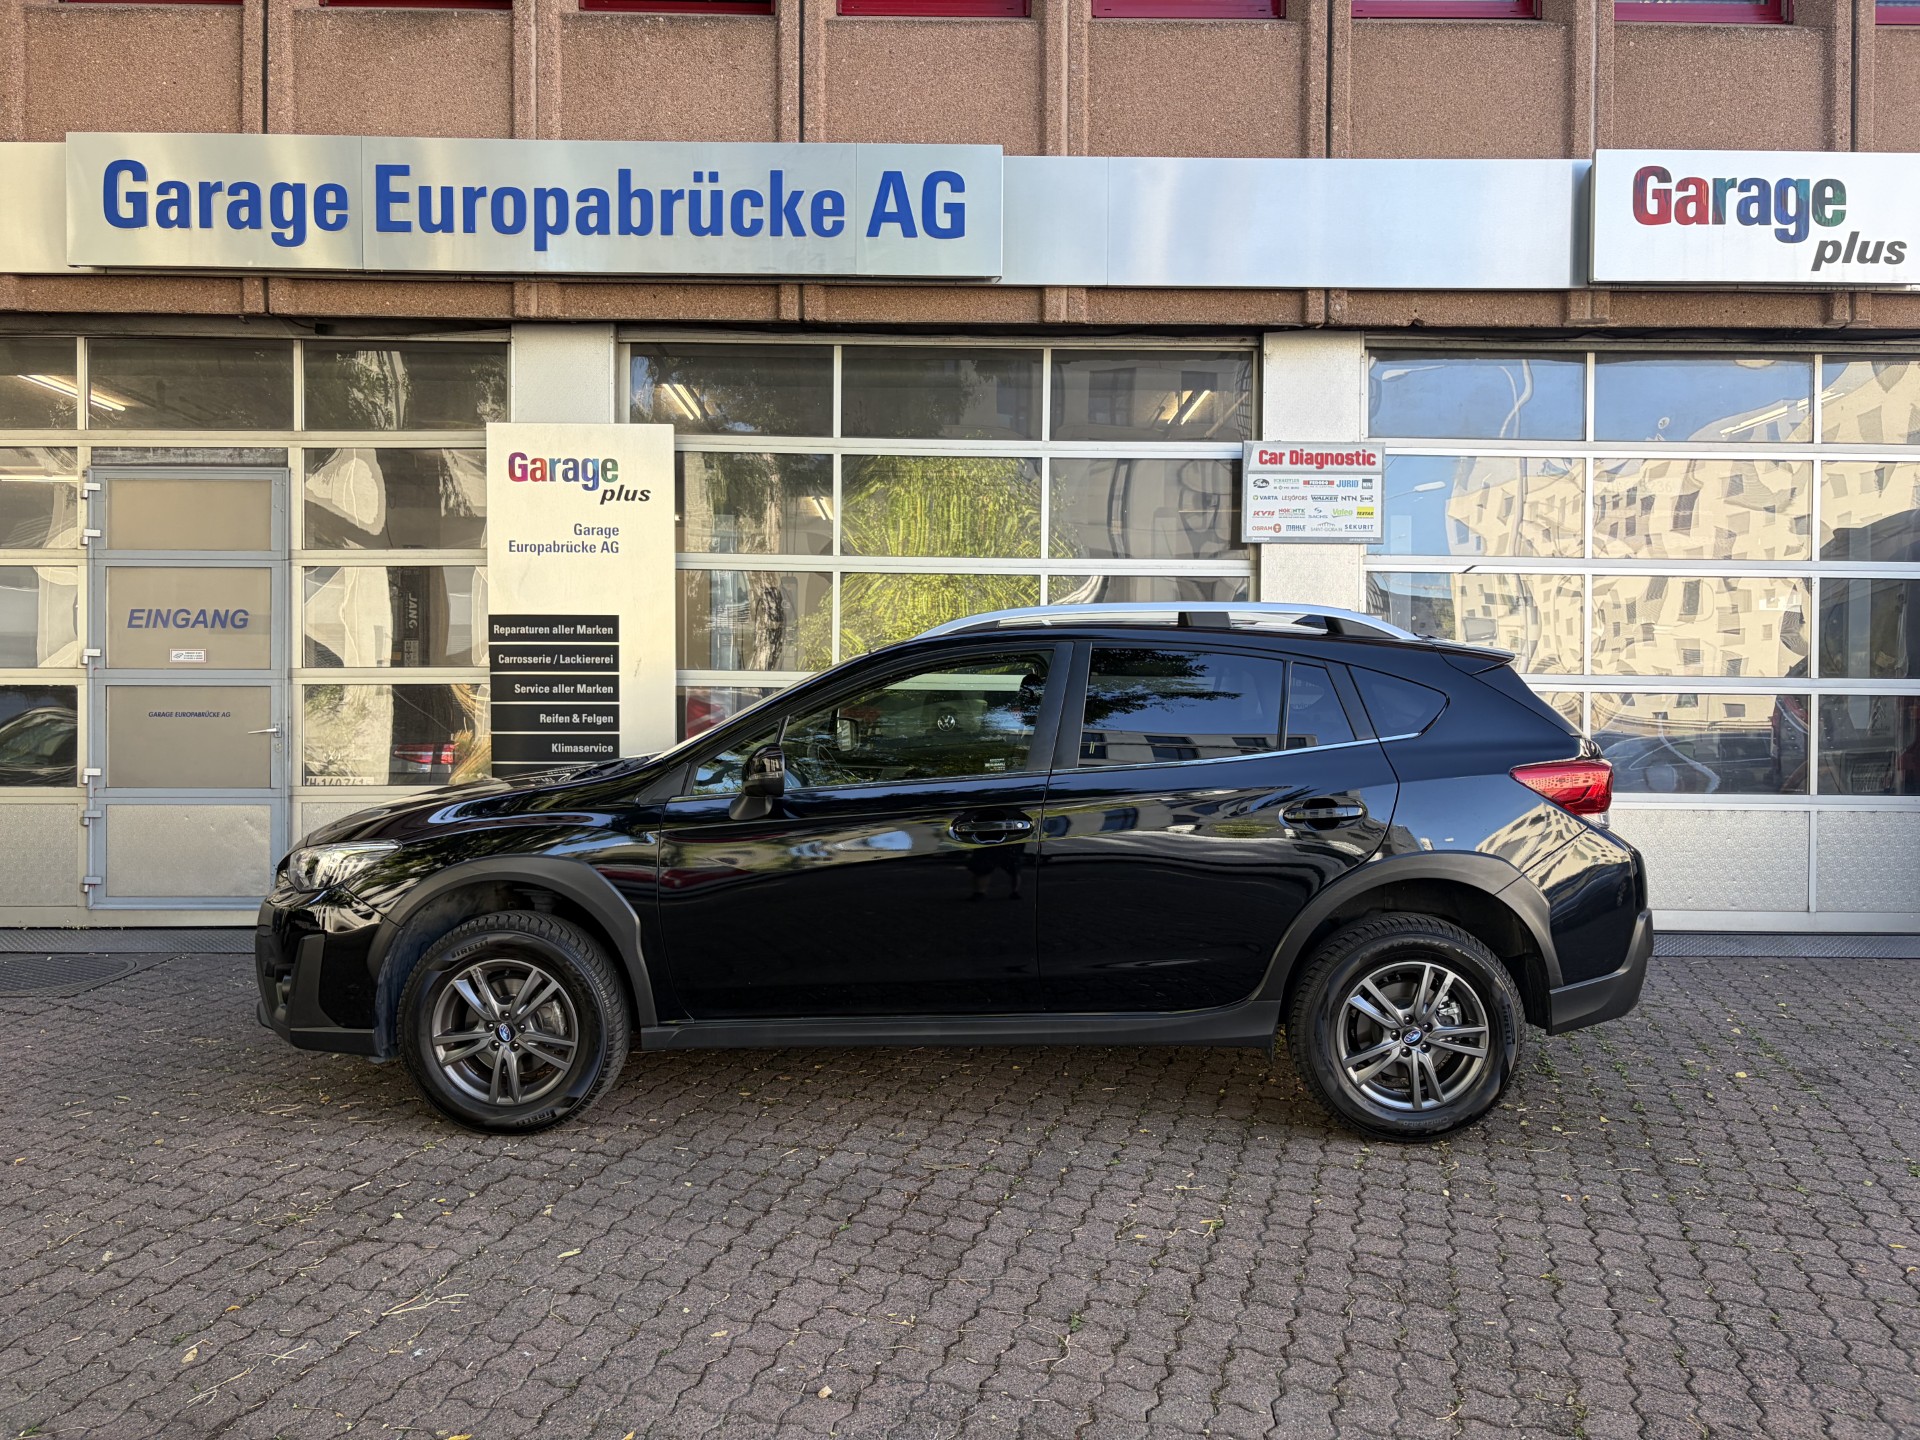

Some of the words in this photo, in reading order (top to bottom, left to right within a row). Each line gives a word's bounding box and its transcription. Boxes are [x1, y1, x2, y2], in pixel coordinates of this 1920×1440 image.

[103, 159, 349, 248] Garage
[375, 164, 846, 252] Europabrücke
[866, 169, 967, 240] AG
[1632, 165, 1847, 244] Garage
[1811, 231, 1908, 272] plus
[1258, 449, 1286, 465] Car
[1289, 448, 1377, 470] Diagnostic
[508, 452, 620, 492] Garage
[1336, 479, 1359, 488] JURID
[599, 484, 652, 506] plus
[573, 523, 620, 538] Garage
[508, 540, 597, 556] Europabrücke
[600, 540, 620, 554] AG
[127, 608, 250, 630] EINGANG
[493, 624, 550, 637] Reparaturen
[552, 624, 575, 635] aller
[576, 624, 614, 635] Marken
[498, 654, 552, 665] Carrosserie
[553, 654, 558, 665] /
[559, 654, 614, 665] Lackiererei
[514, 684, 549, 695] Service
[551, 684, 575, 694] aller
[576, 684, 614, 695] Marken
[174, 710, 220, 718] EUROPABRÜCKE
[539, 713, 570, 724] Reifen
[571, 713, 581, 724] &
[582, 713, 614, 726] Felgen
[551, 743, 614, 754] Klimaservice
